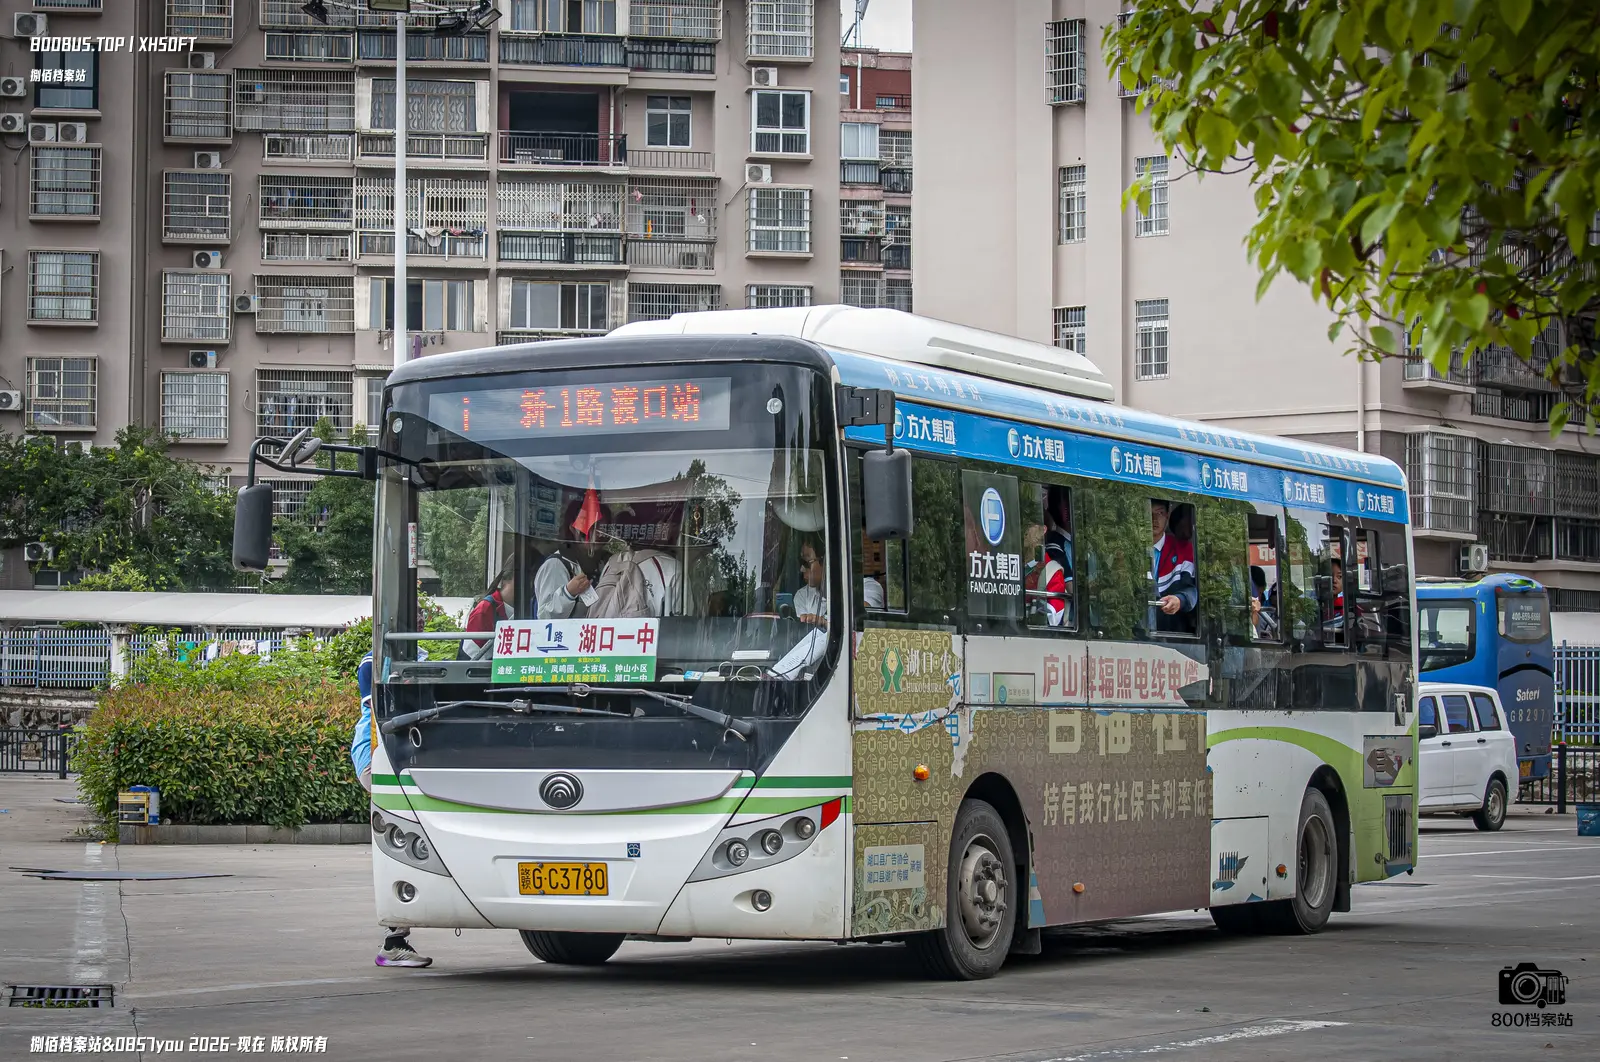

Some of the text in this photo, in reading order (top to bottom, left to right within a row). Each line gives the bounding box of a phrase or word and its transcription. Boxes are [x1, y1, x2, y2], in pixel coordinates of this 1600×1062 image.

[907, 413, 955, 445] 方大集团
[1023, 434, 1065, 463] 方大集团
[1124, 451, 1162, 478] 方大集团
[1213, 467, 1248, 492] 方大集团
[1294, 481, 1325, 504] 方大集团
[1367, 492, 1395, 514] 方大集团
[969, 550, 1020, 581] 方大集团
[970, 581, 1021, 596] FANGDA GROUP
[497, 622, 655, 656] 渡口 1路 湖口一中
[1516, 687, 1540, 702] Sateri
[1043, 778, 1213, 826] 持有我行社保卡利率低
